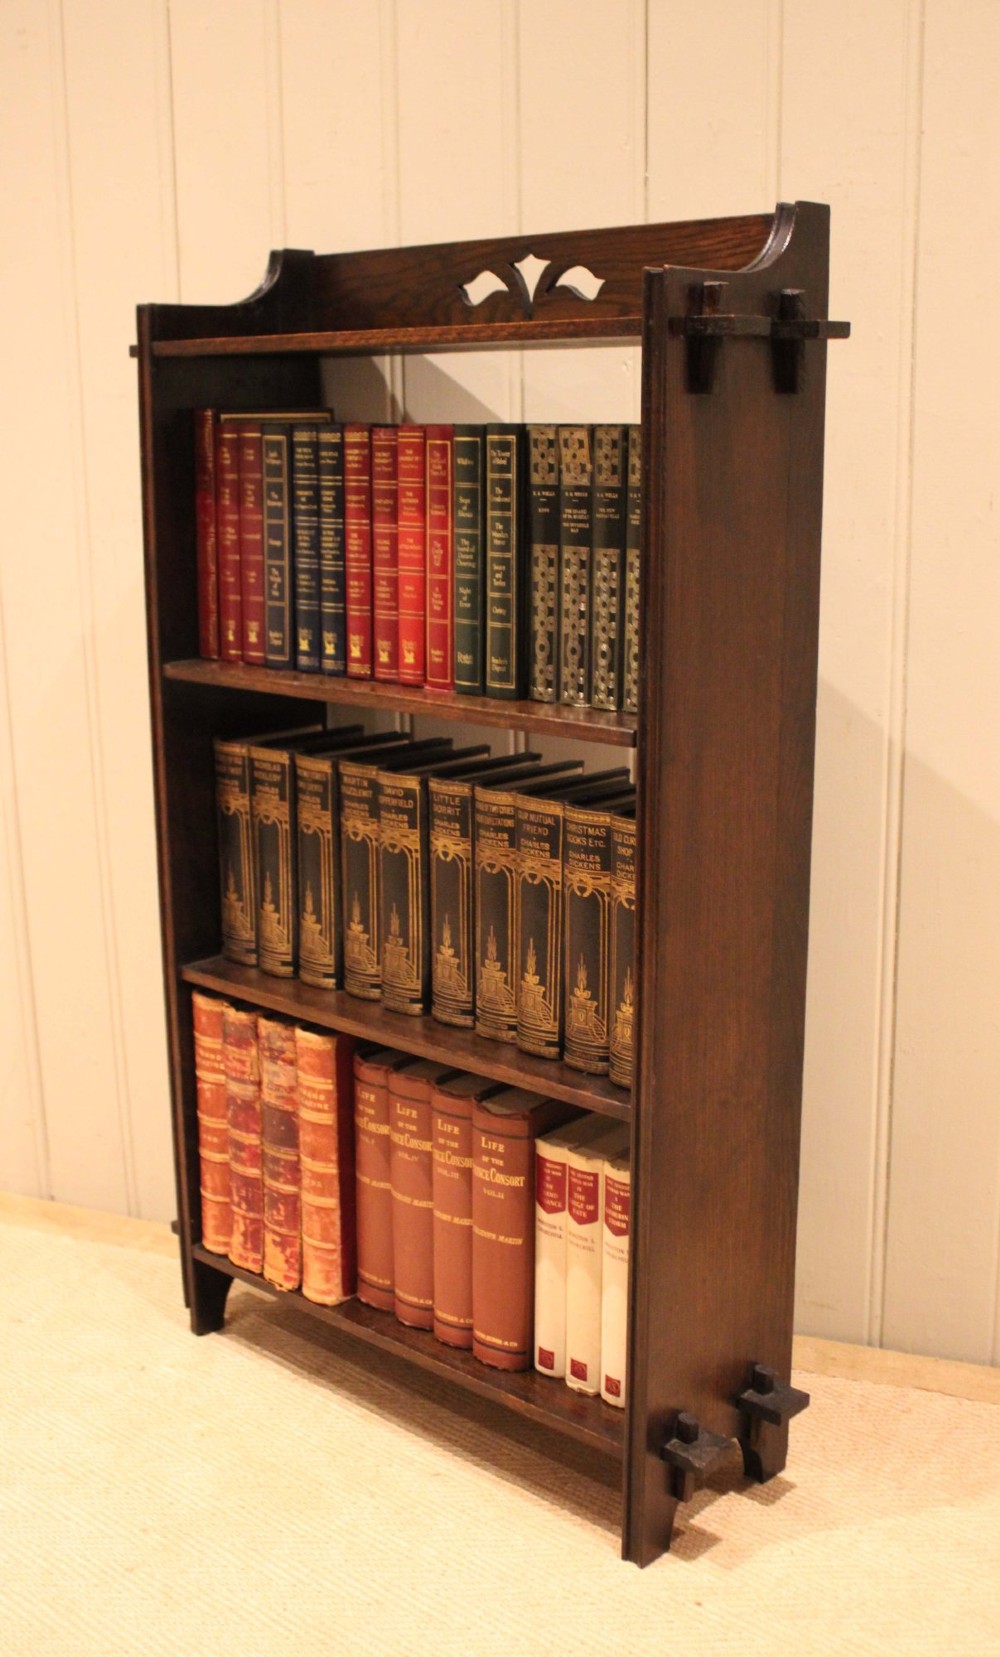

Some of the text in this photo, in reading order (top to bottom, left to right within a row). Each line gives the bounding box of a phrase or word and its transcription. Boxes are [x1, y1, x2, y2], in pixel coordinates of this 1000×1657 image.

[432, 792, 462, 806] LITTLE
[529, 813, 556, 826] MUTUAL
[522, 823, 549, 836] FRIEND
[520, 838, 550, 851] CHARLES
[568, 850, 601, 862] CHARLES
[568, 858, 602, 870] DICKENS
[616, 862, 635, 873] CHAR
[396, 1102, 418, 1119] LIFE
[437, 1118, 460, 1135] LIFE
[404, 1133, 433, 1152] CONSOR
[446, 1140, 459, 1149] THE
[481, 1136, 505, 1153] LIFE
[446, 1150, 474, 1168] CONSO
[490, 1157, 504, 1166] THE
[490, 1168, 526, 1188] CONSORT
[610, 1202, 623, 1212] THE
